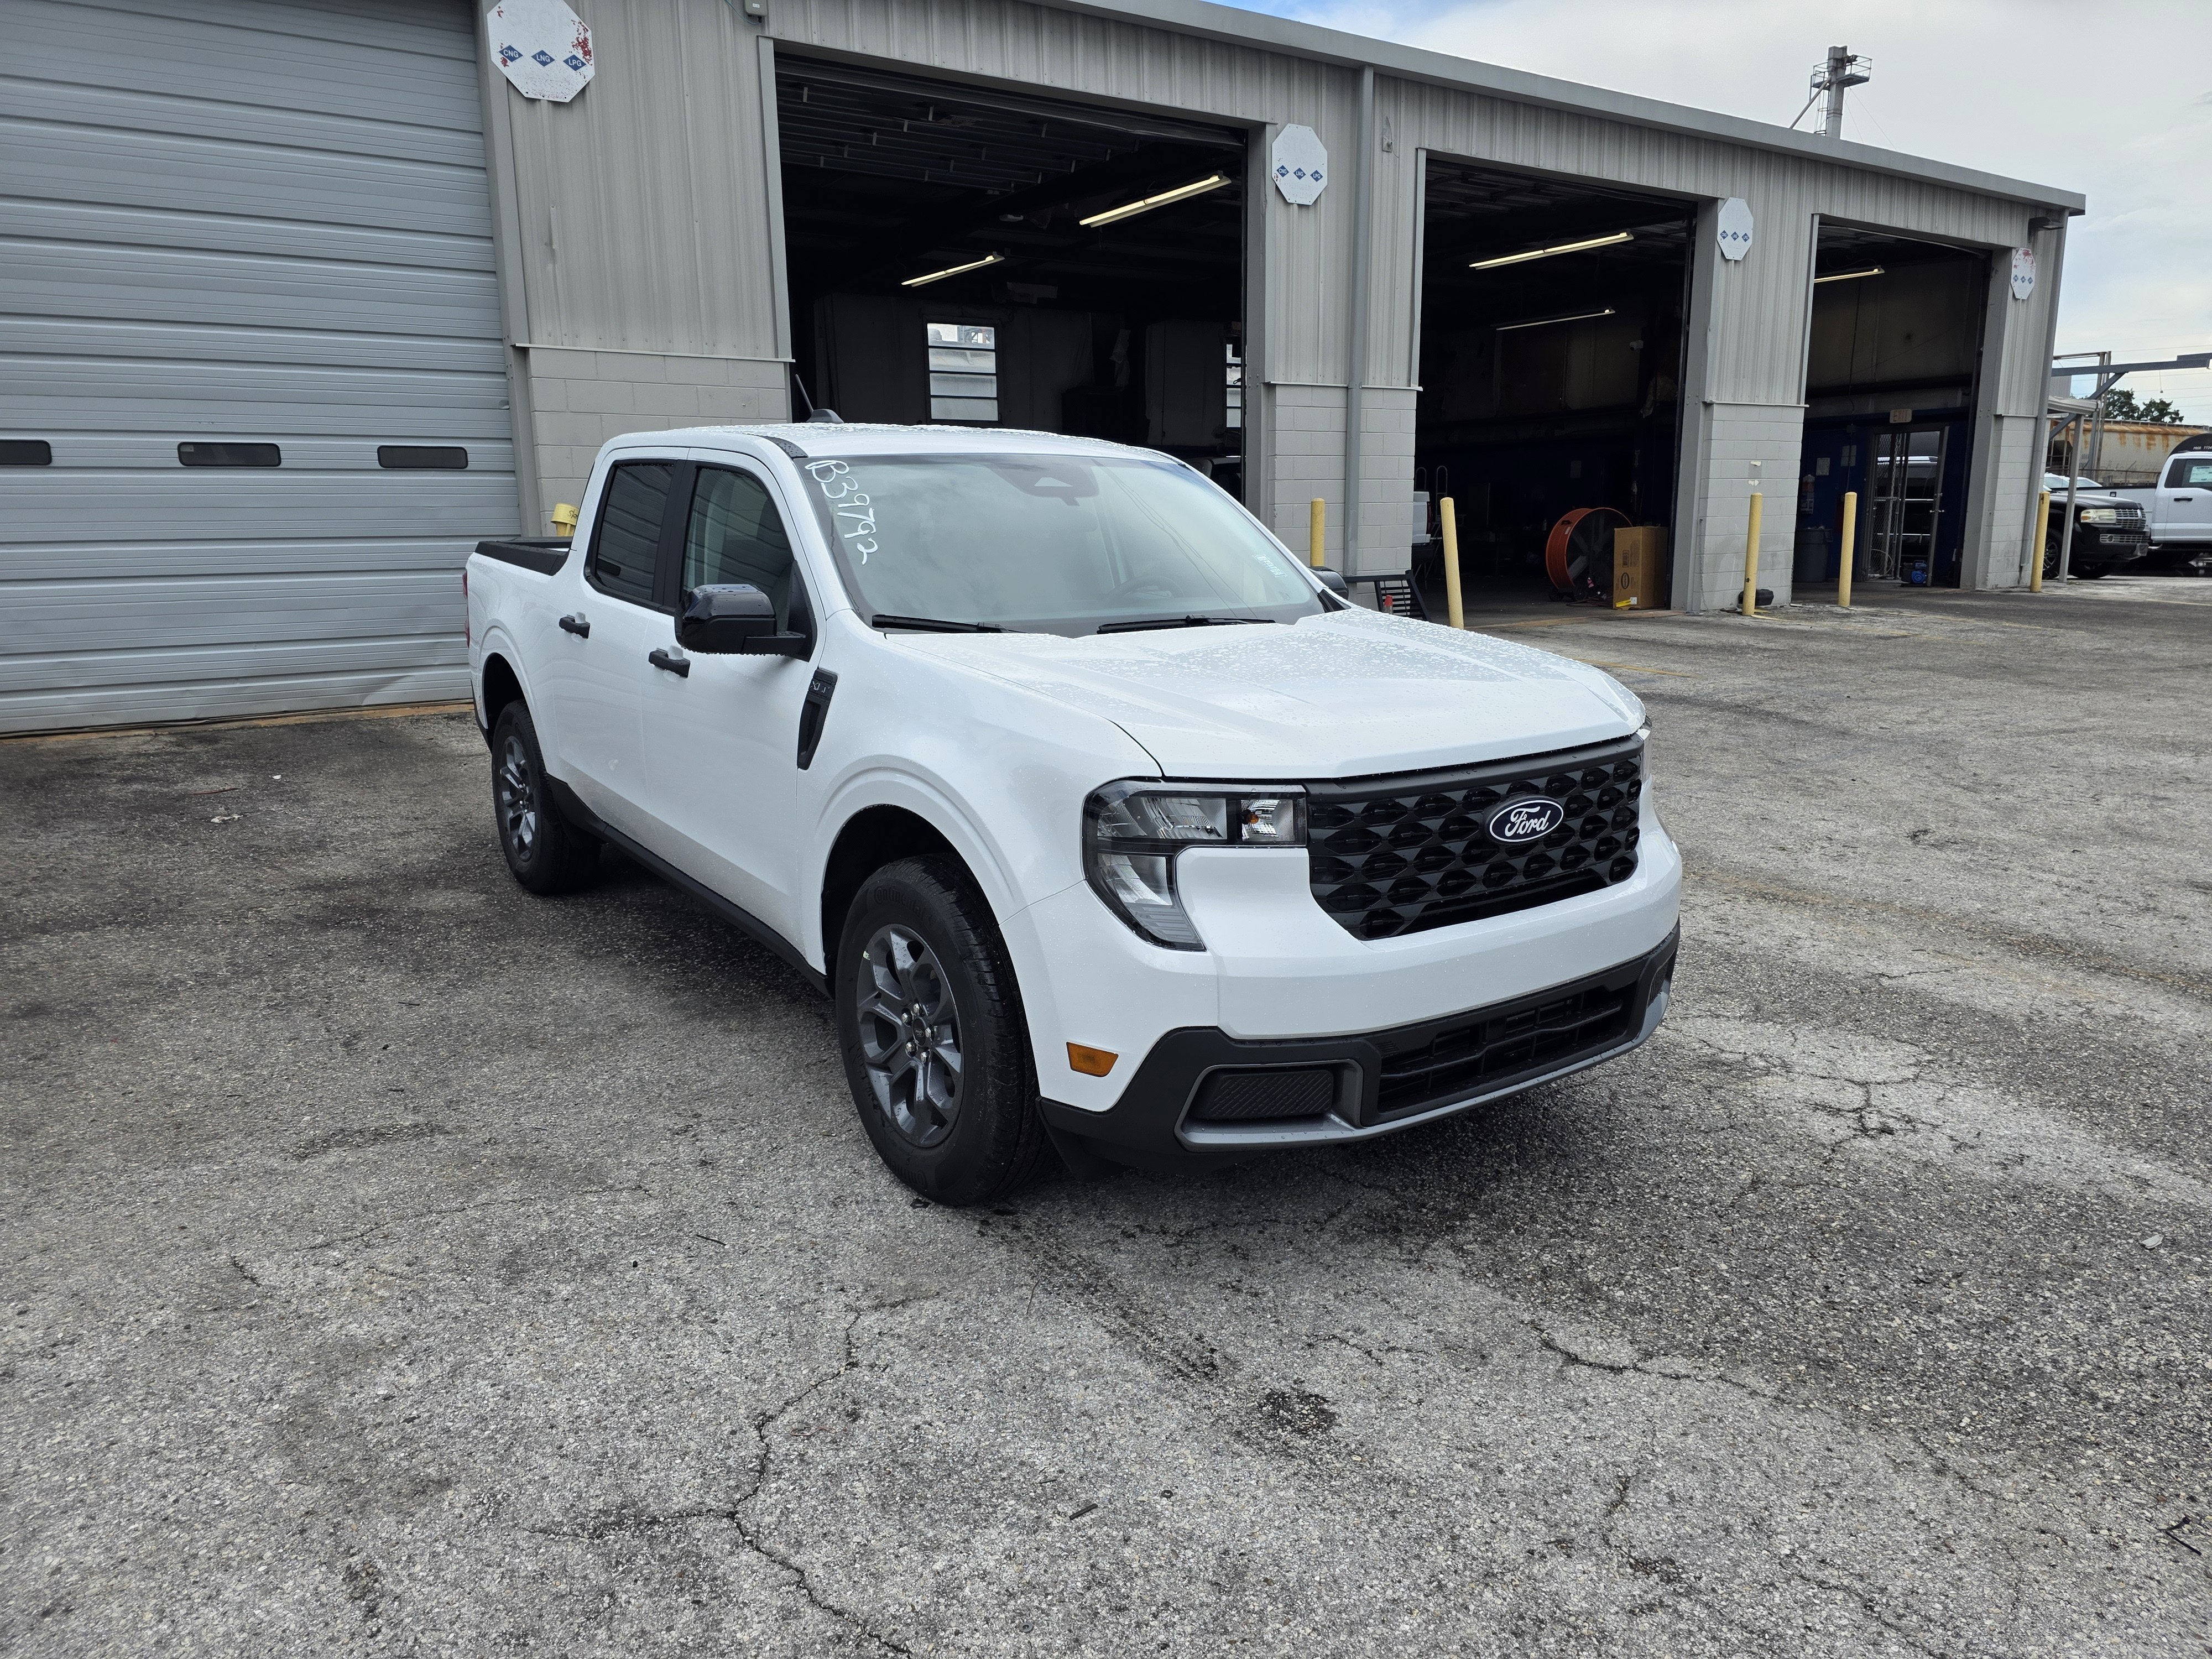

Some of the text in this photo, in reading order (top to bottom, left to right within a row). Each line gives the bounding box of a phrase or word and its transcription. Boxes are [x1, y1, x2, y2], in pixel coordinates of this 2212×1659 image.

[503, 49, 582, 67] CNG LNG LPG
[805, 460, 878, 565] B39792
[810, 681, 830, 693] XLT
[1504, 806, 1551, 837] Ford
